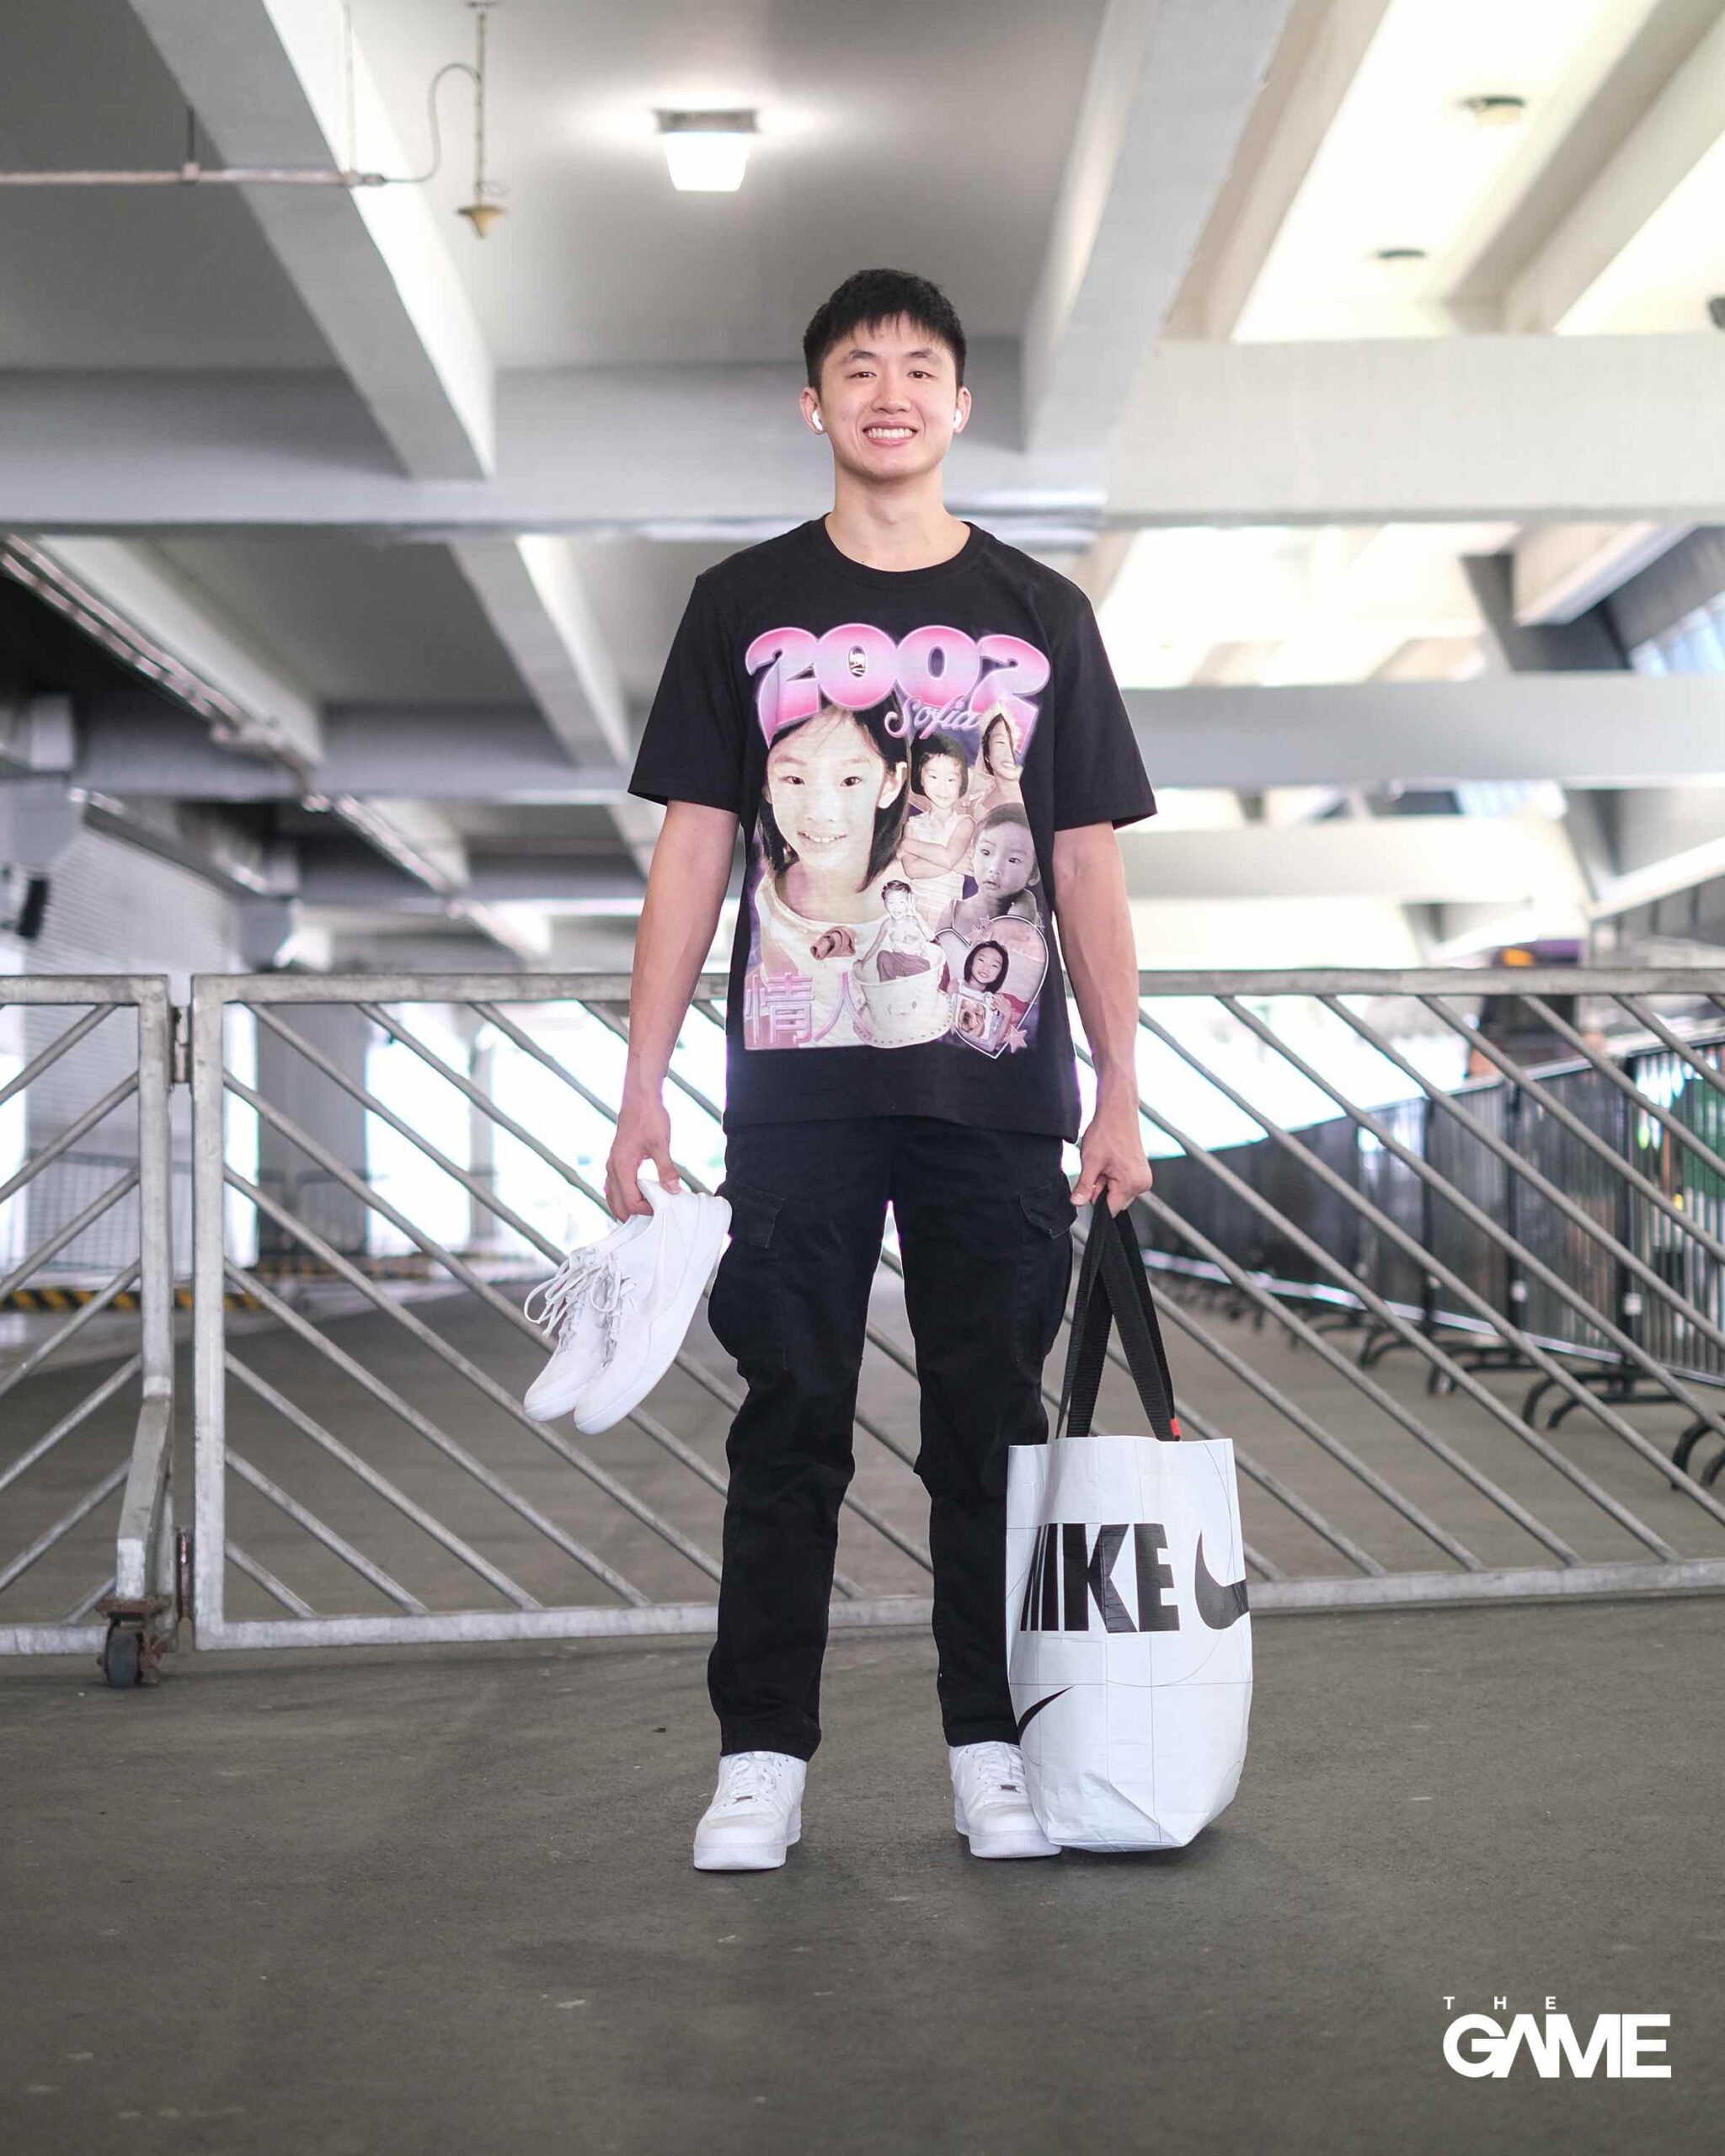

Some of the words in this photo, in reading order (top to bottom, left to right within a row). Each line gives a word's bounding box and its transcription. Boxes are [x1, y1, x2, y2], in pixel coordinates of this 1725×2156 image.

[745, 622, 1050, 758] 2002
[884, 695, 983, 739] Sofia
[745, 972, 873, 1044] 情人
[1020, 1523, 1180, 1634] NIKE
